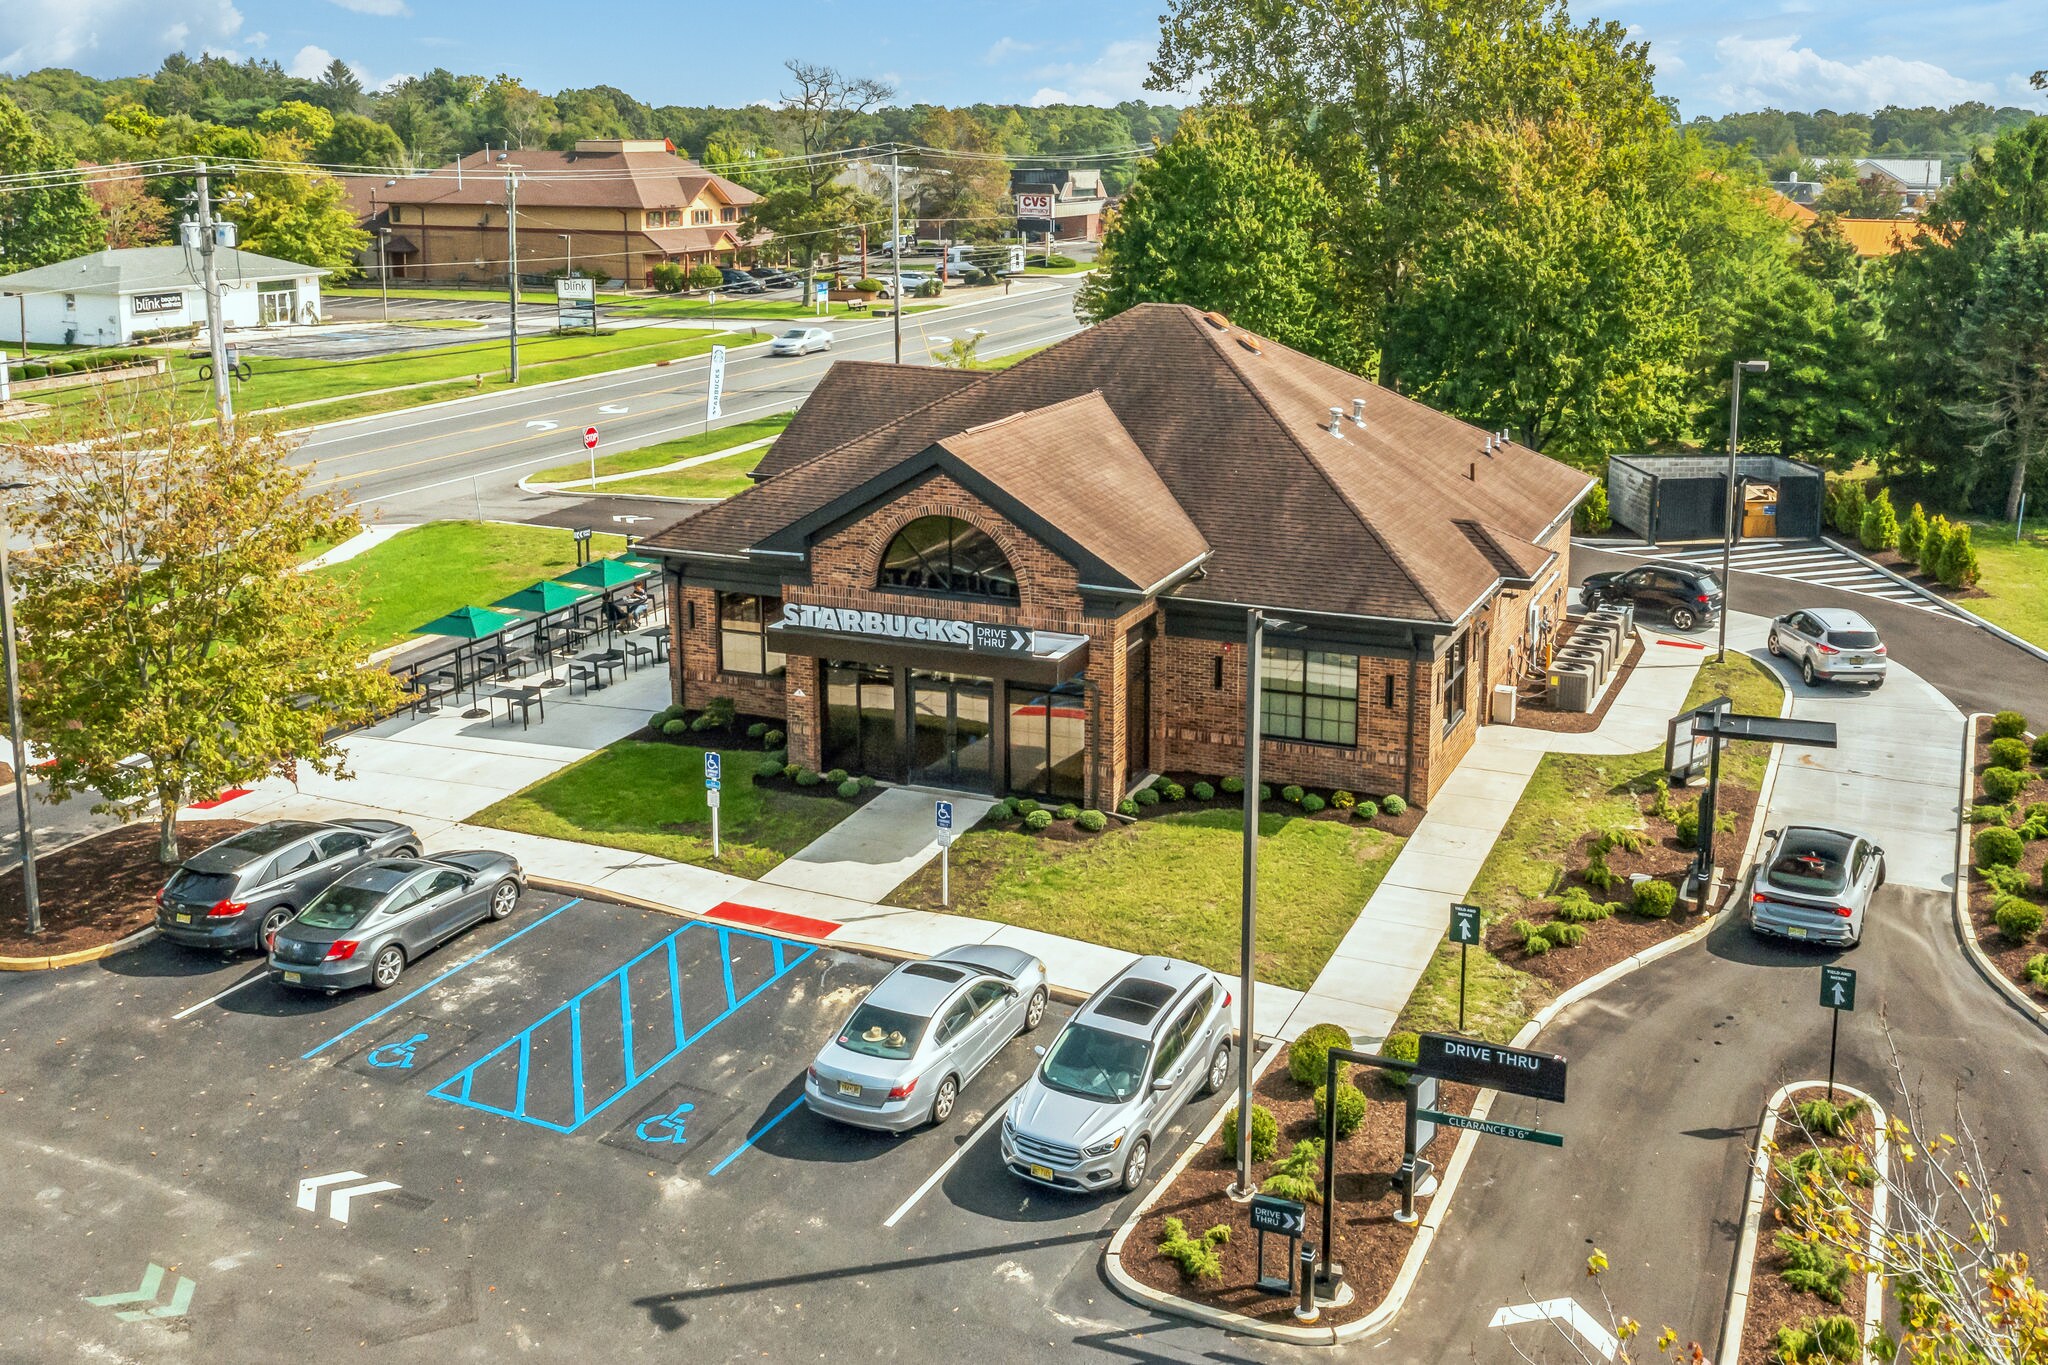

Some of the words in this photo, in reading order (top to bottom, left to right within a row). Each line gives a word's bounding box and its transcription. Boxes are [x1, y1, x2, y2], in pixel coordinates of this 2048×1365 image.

[1023, 196, 1047, 207] CVS
[564, 280, 587, 291] blink
[135, 297, 161, 311] blink
[585, 433, 598, 443] STOP
[783, 603, 970, 645] STARBUCKS
[976, 627, 1007, 639] DRIVE
[977, 637, 1006, 649] THRU
[1445, 1042, 1491, 1061] DRIVE
[1496, 1054, 1540, 1070] THRU
[1449, 1117, 1506, 1136] CLEARANCE
[1255, 1207, 1281, 1219] DRIVE
[1256, 1215, 1279, 1226] THRU
